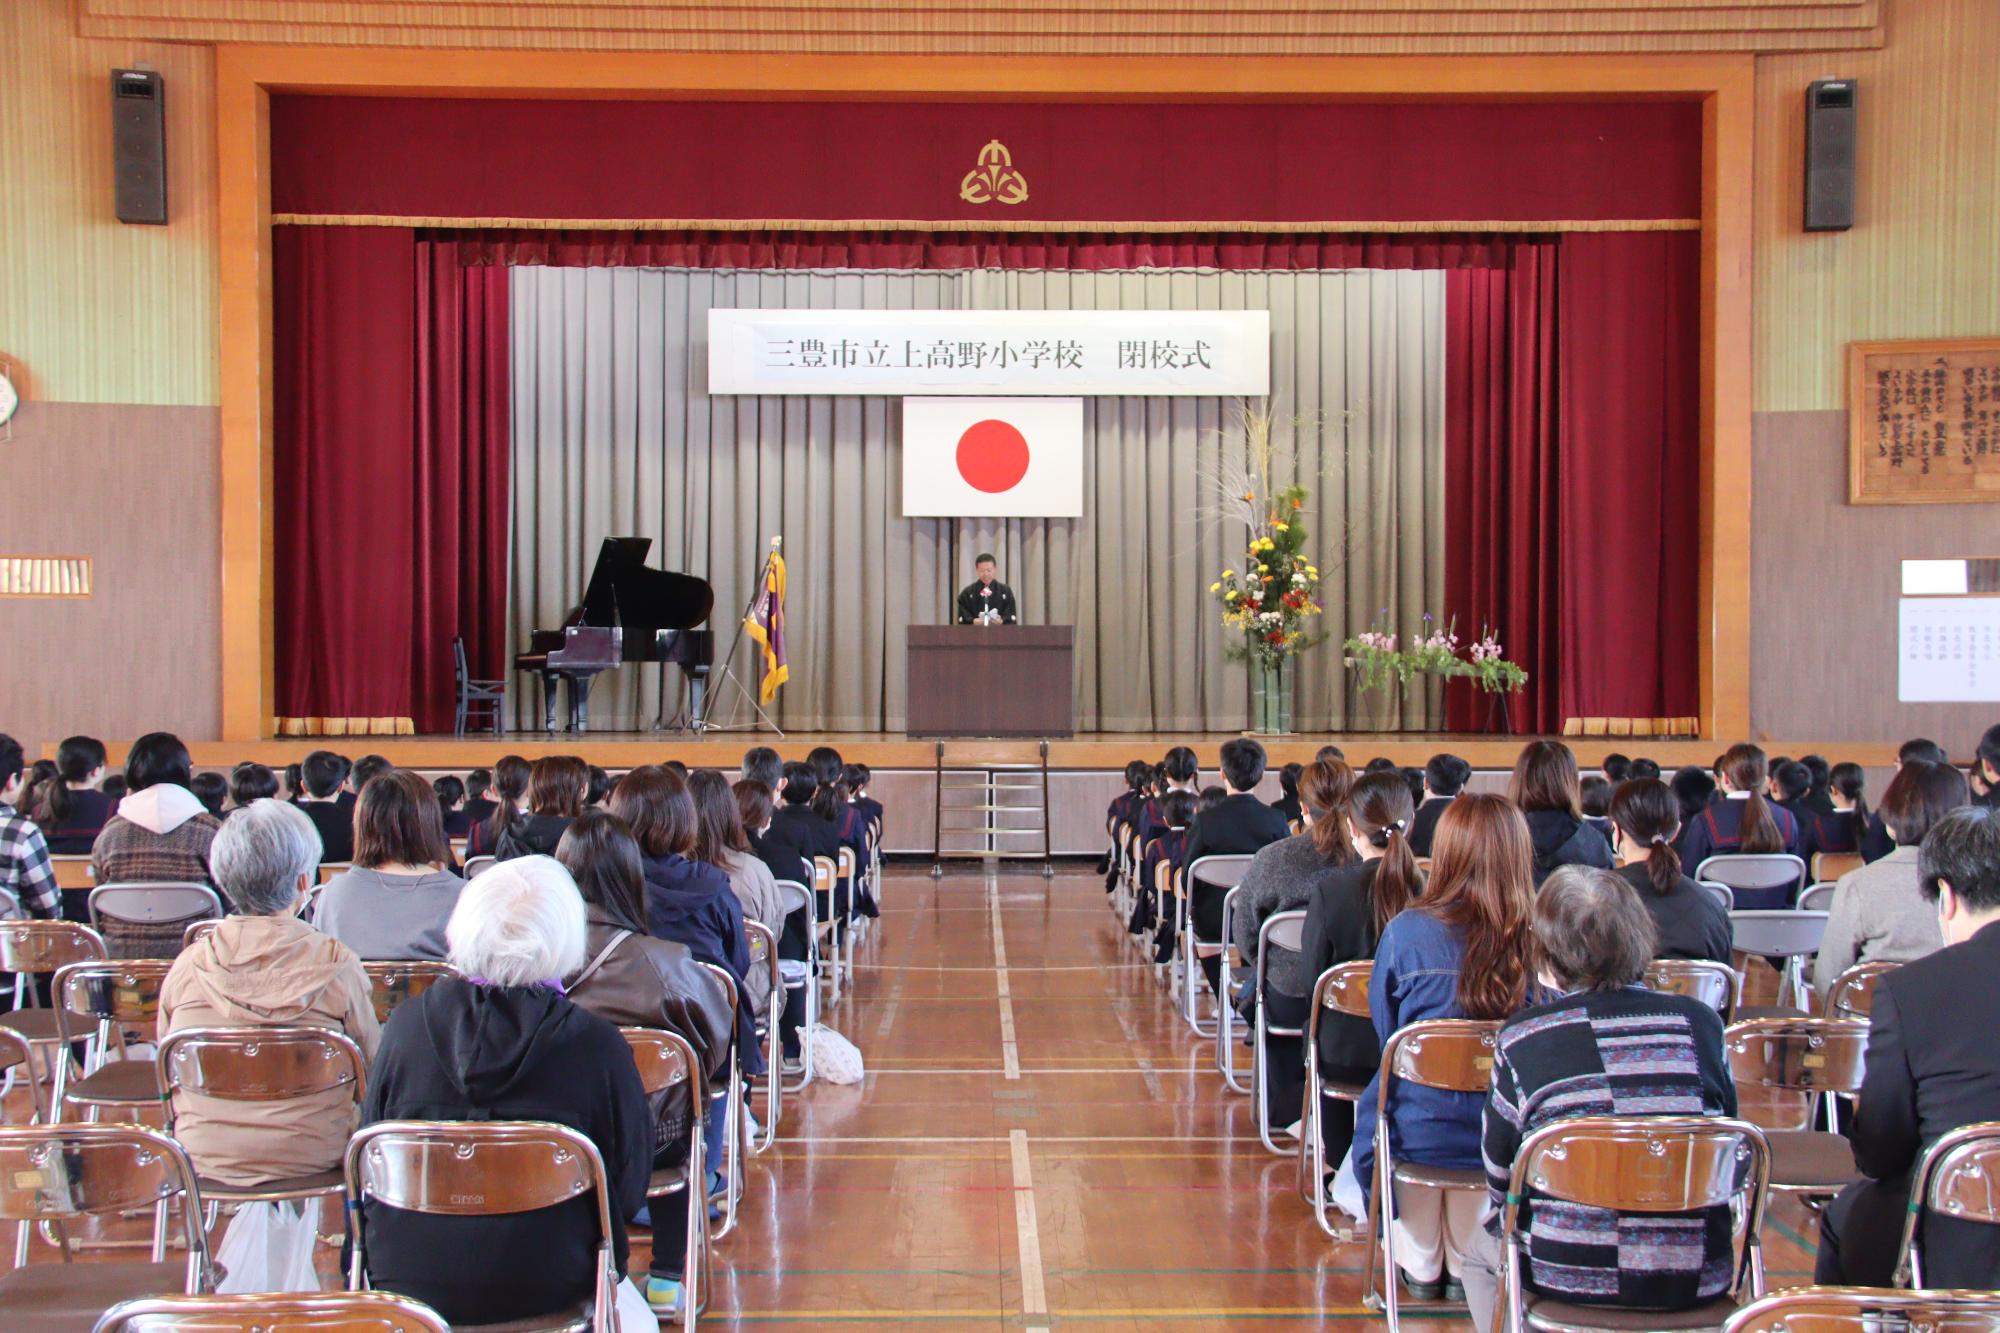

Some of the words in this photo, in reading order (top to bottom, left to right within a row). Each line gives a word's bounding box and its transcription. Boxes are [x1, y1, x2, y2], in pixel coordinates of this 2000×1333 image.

[765, 338, 1084, 370] 三豊市立上高野小学校
[1118, 339, 1212, 370] 閉校式
